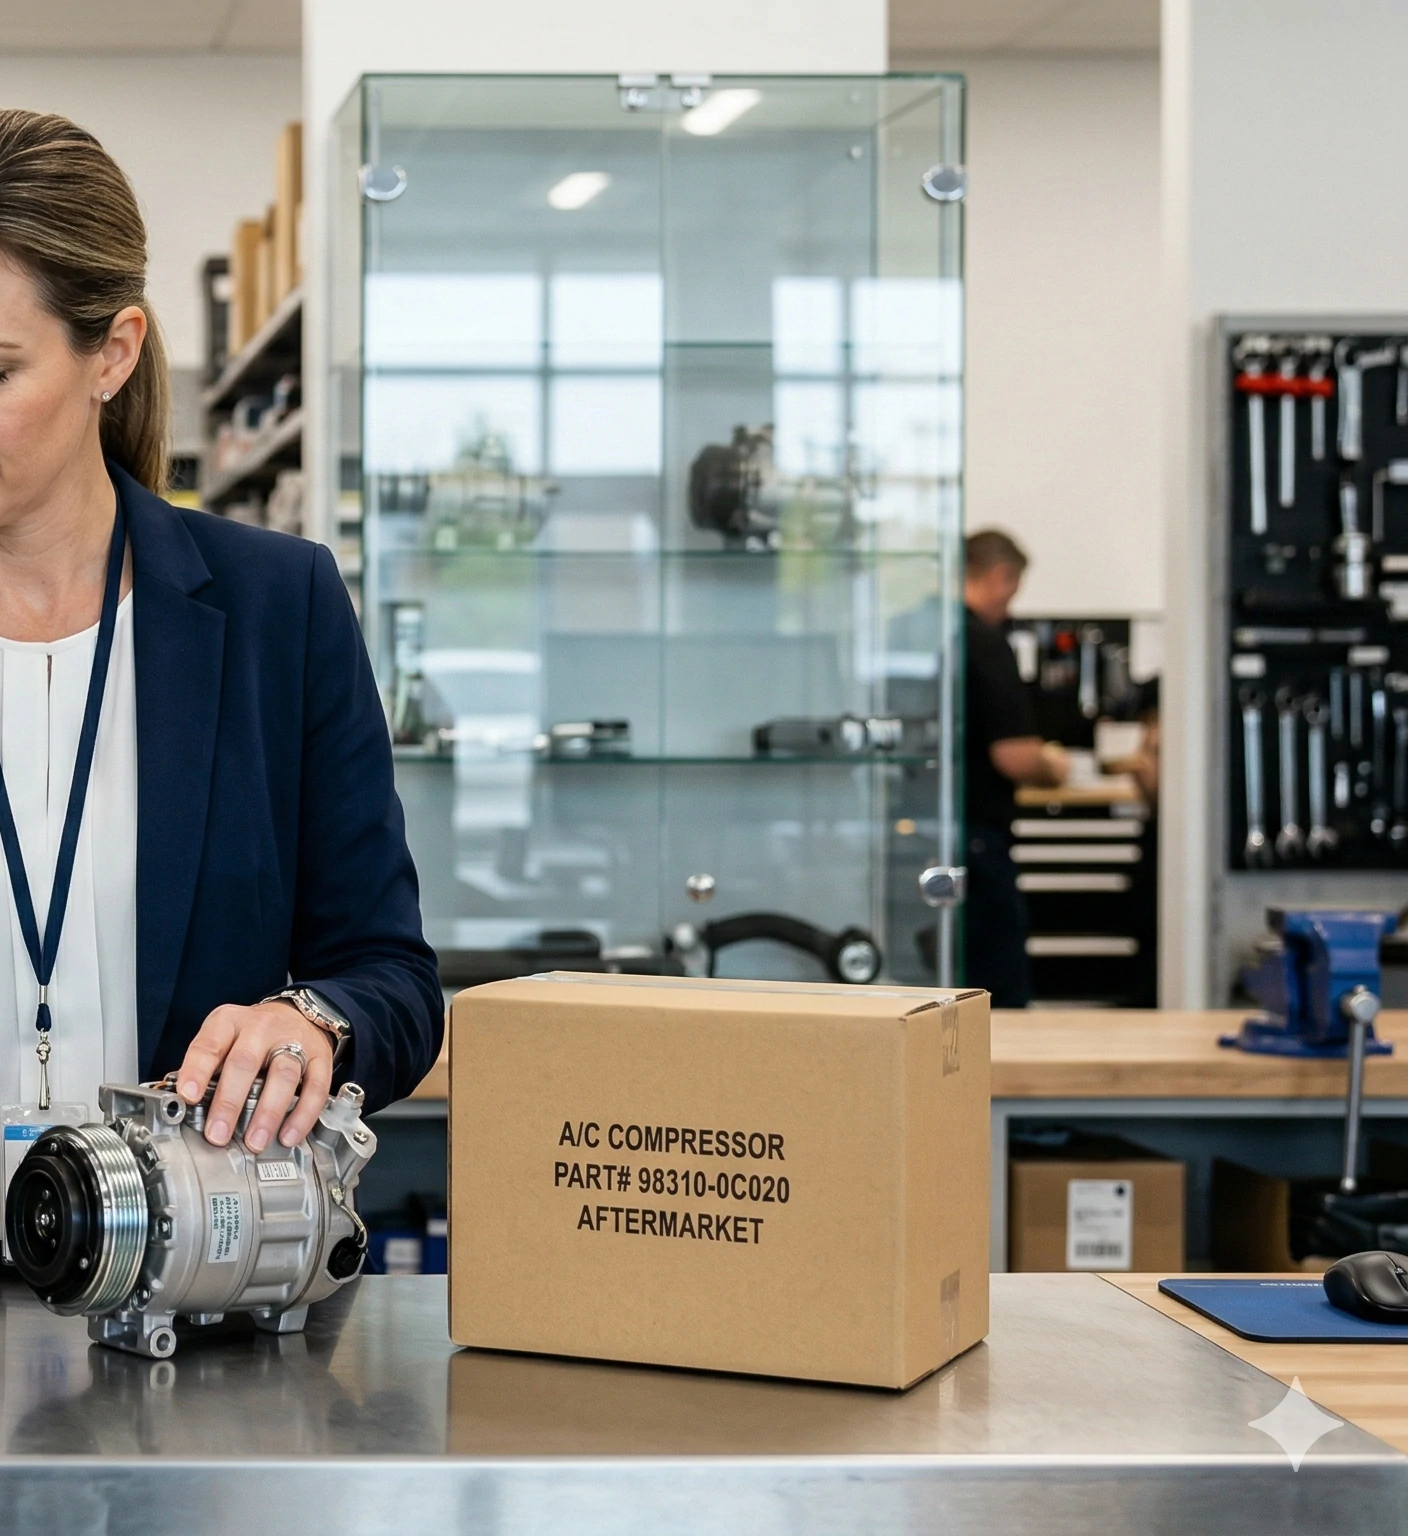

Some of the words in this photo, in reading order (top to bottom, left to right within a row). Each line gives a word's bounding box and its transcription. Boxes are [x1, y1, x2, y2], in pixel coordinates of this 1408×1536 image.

[558, 1121, 600, 1149] A/C
[608, 1123, 785, 1160] COMPRESSOR
[554, 1161, 631, 1192] PART#
[638, 1167, 790, 1203] 98310-0C020
[577, 1204, 764, 1244] AFTERMARKET
